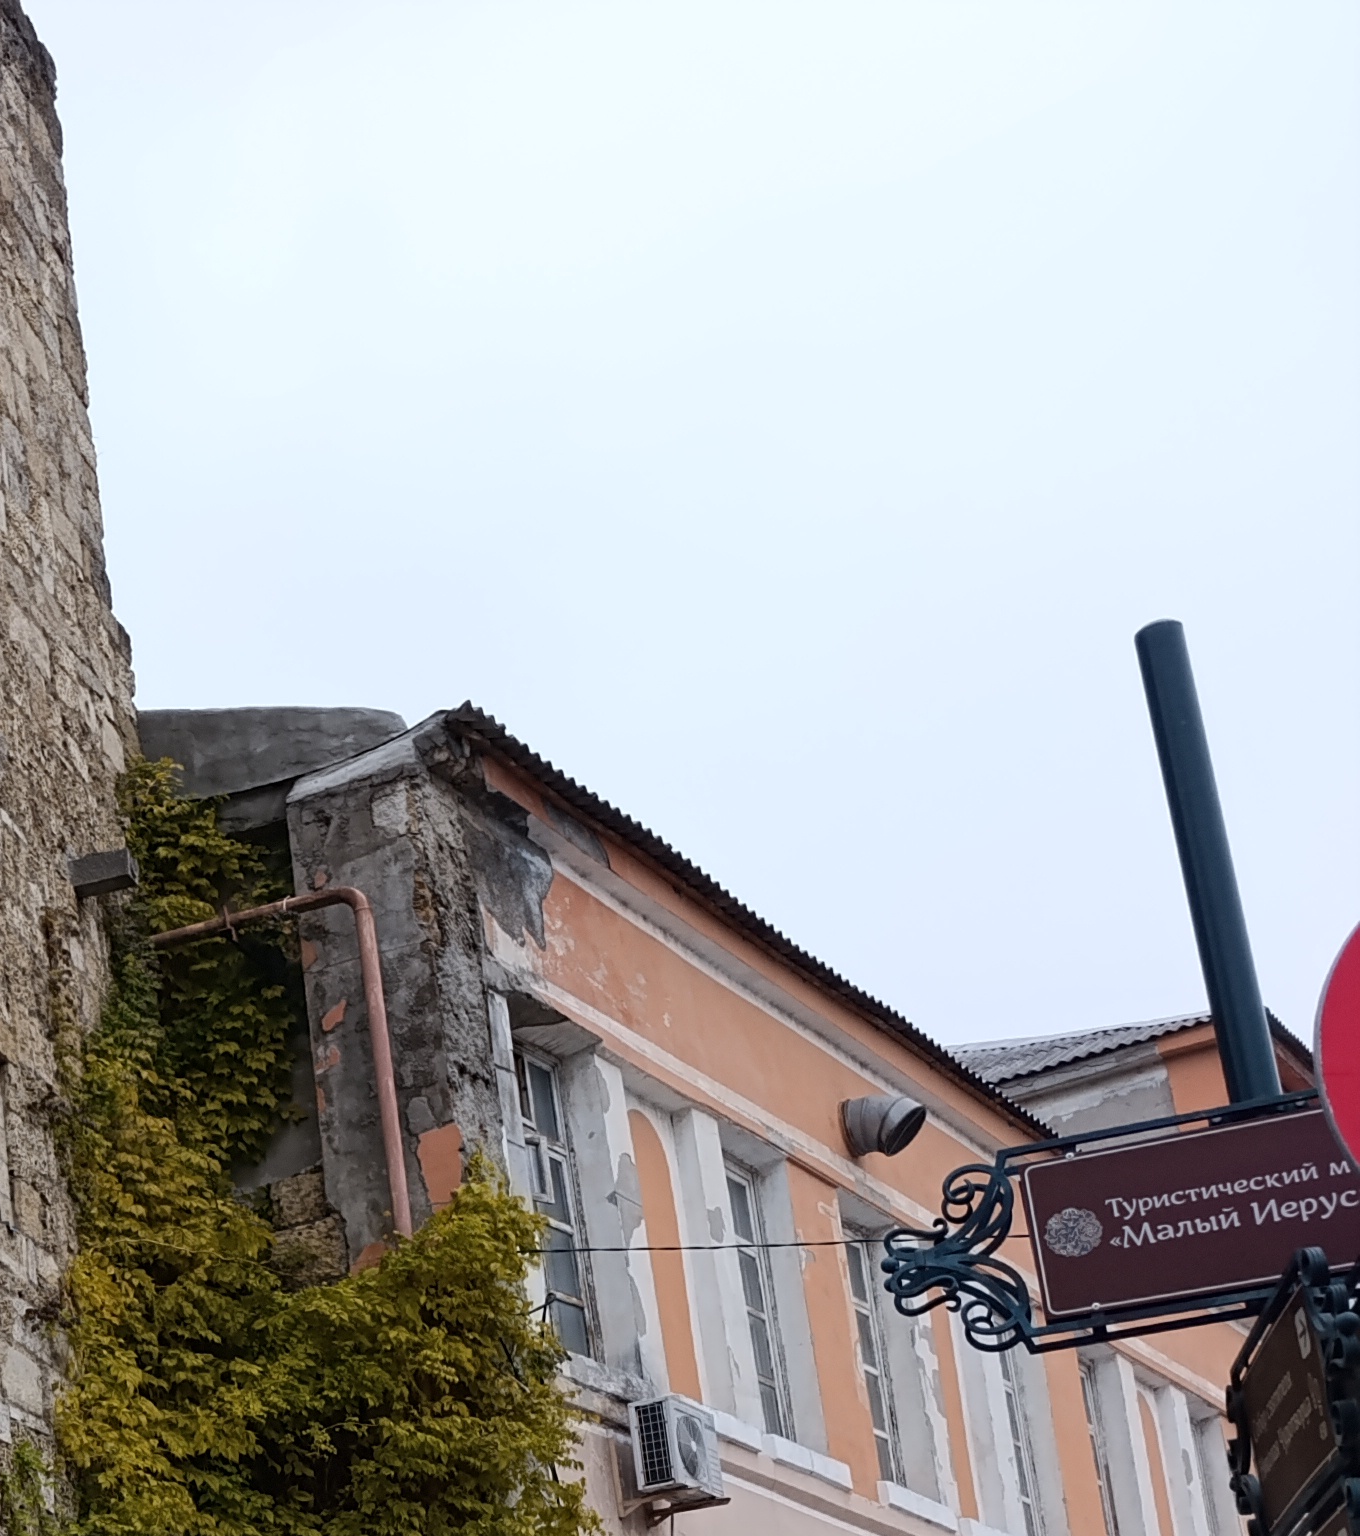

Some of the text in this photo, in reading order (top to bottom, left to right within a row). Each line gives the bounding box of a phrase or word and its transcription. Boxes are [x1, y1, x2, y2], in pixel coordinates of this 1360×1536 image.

[1105, 1162, 1319, 1220] Туристический
[1109, 1189, 1360, 1249] «Малый Иерус
